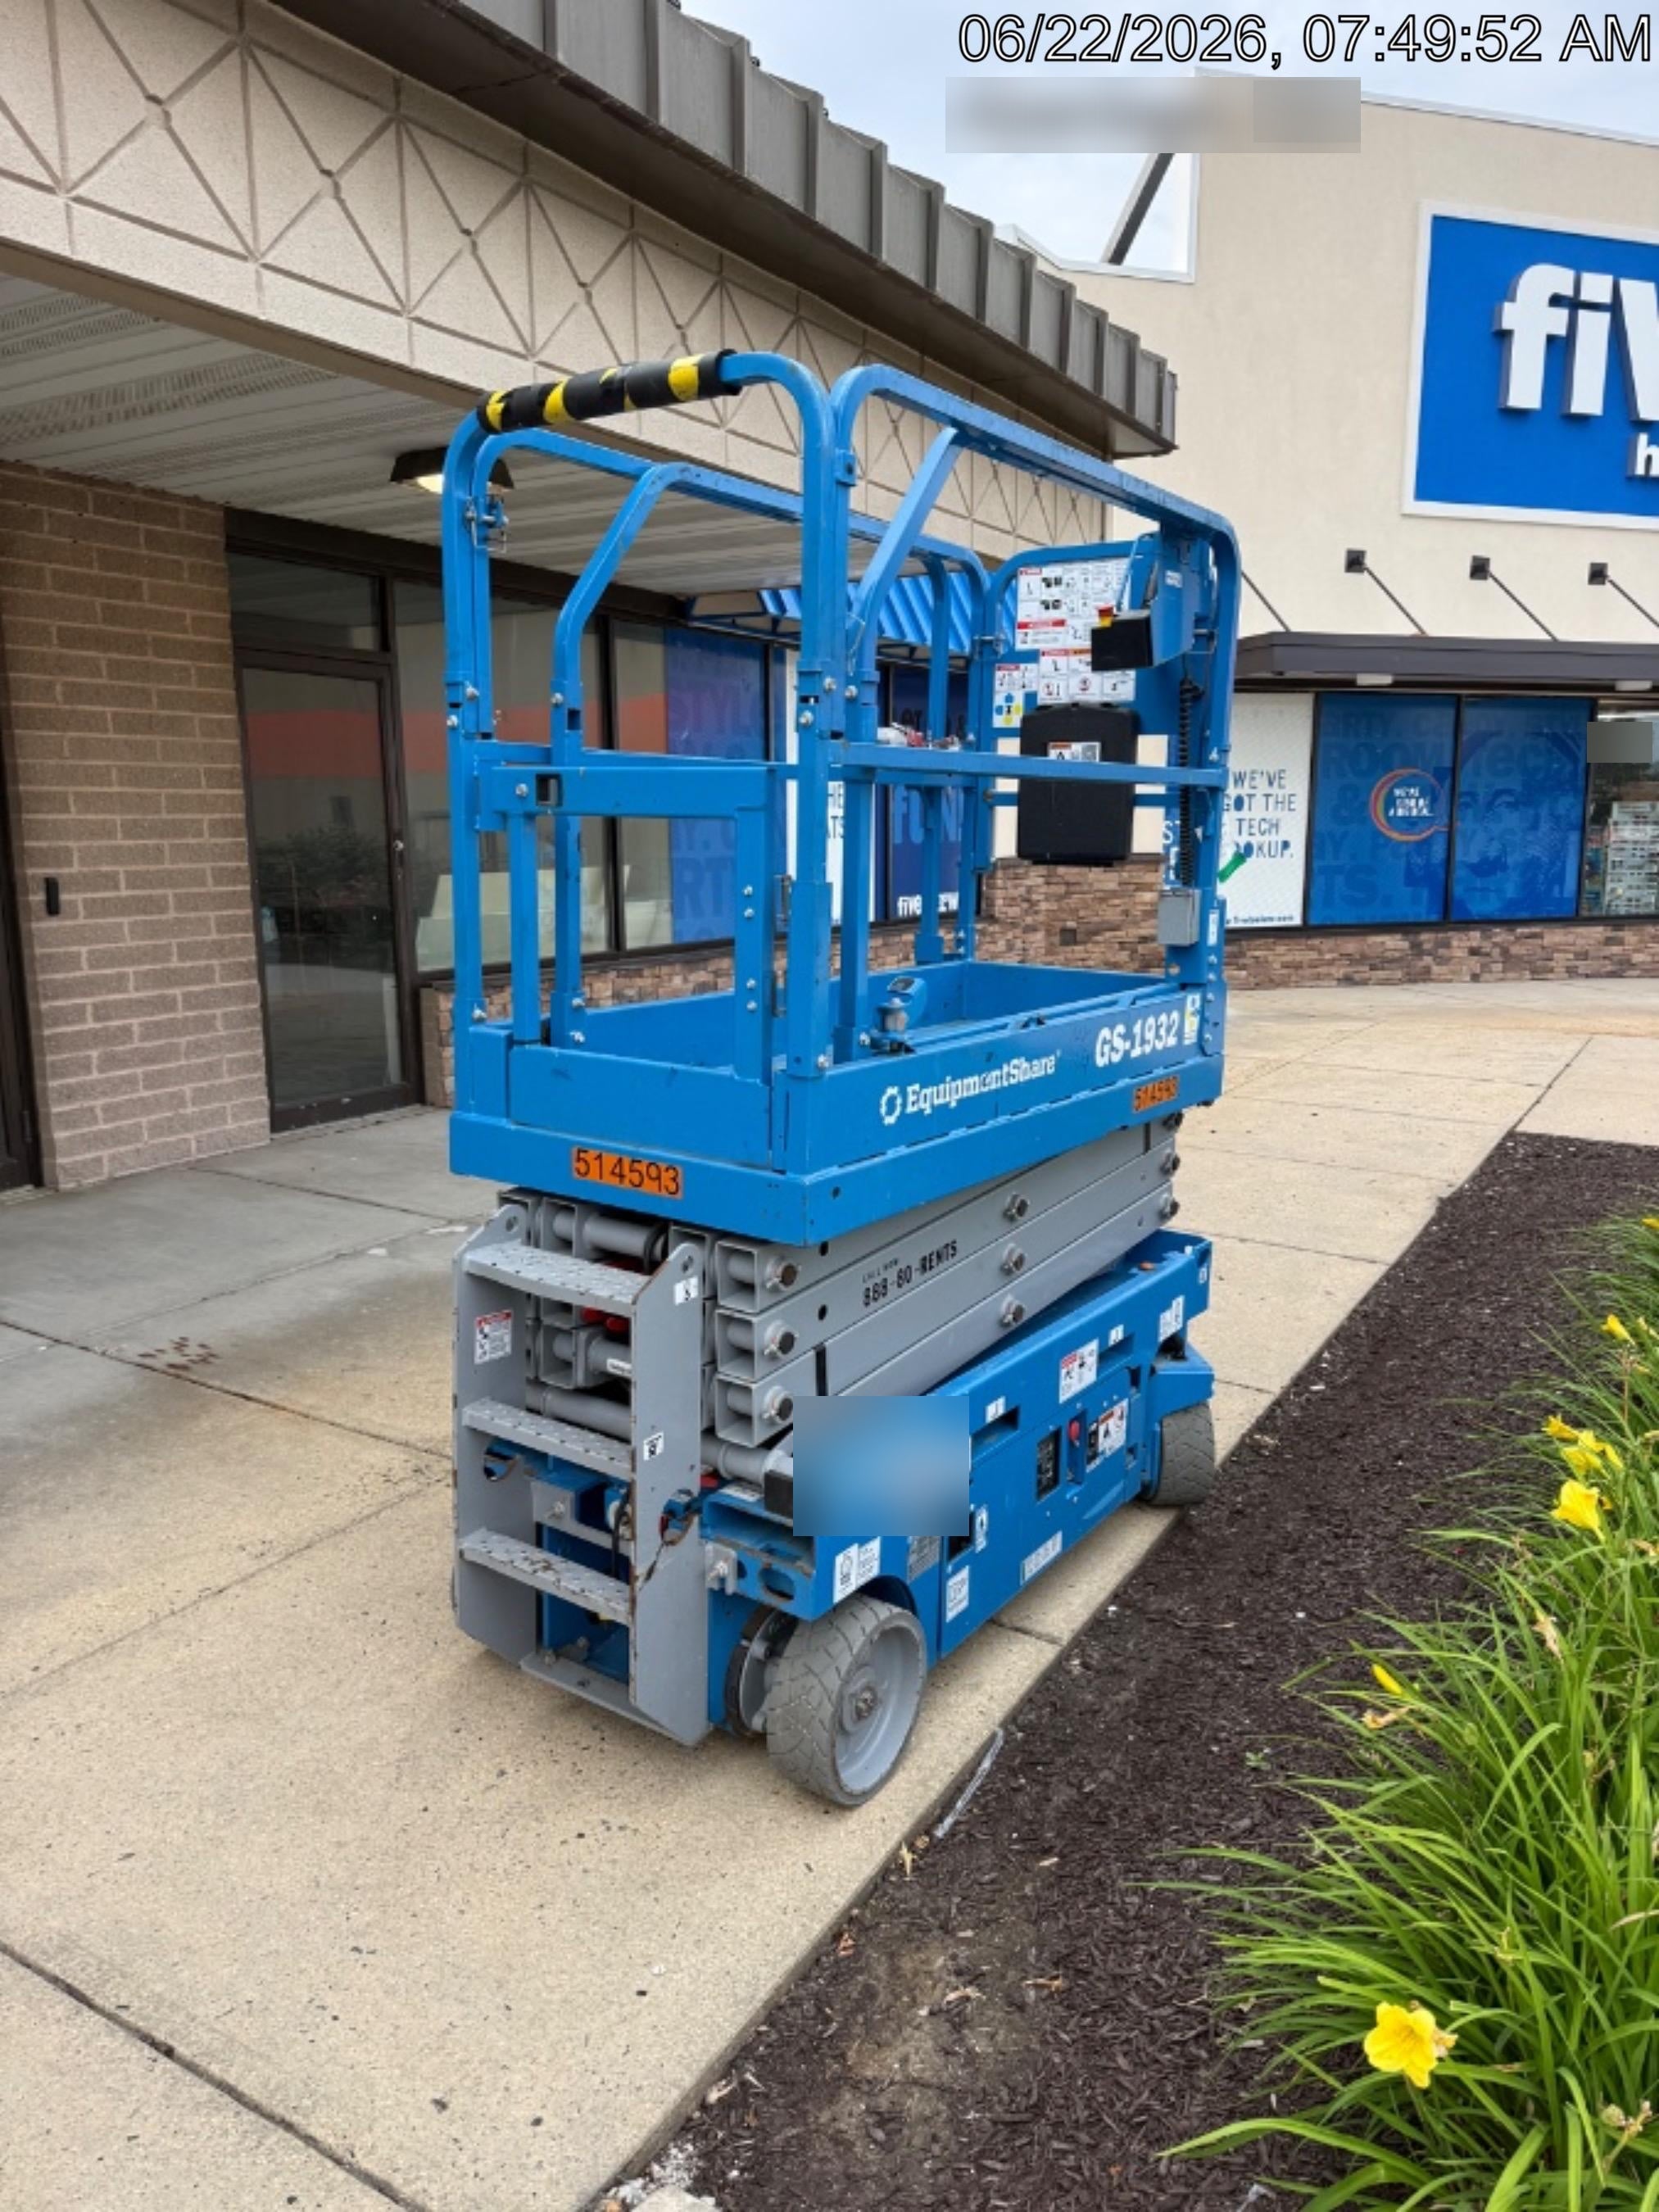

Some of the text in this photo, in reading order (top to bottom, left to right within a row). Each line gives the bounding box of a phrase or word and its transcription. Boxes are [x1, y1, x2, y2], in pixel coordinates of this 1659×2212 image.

[1232, 768, 1287, 790] WE'VE
[1262, 792, 1297, 812] THE
[1235, 817, 1280, 836] TECH
[1095, 1010, 1180, 1067] GS-1932
[904, 1054, 1056, 1116] EquipmentShare
[574, 1148, 680, 1195] 514593
